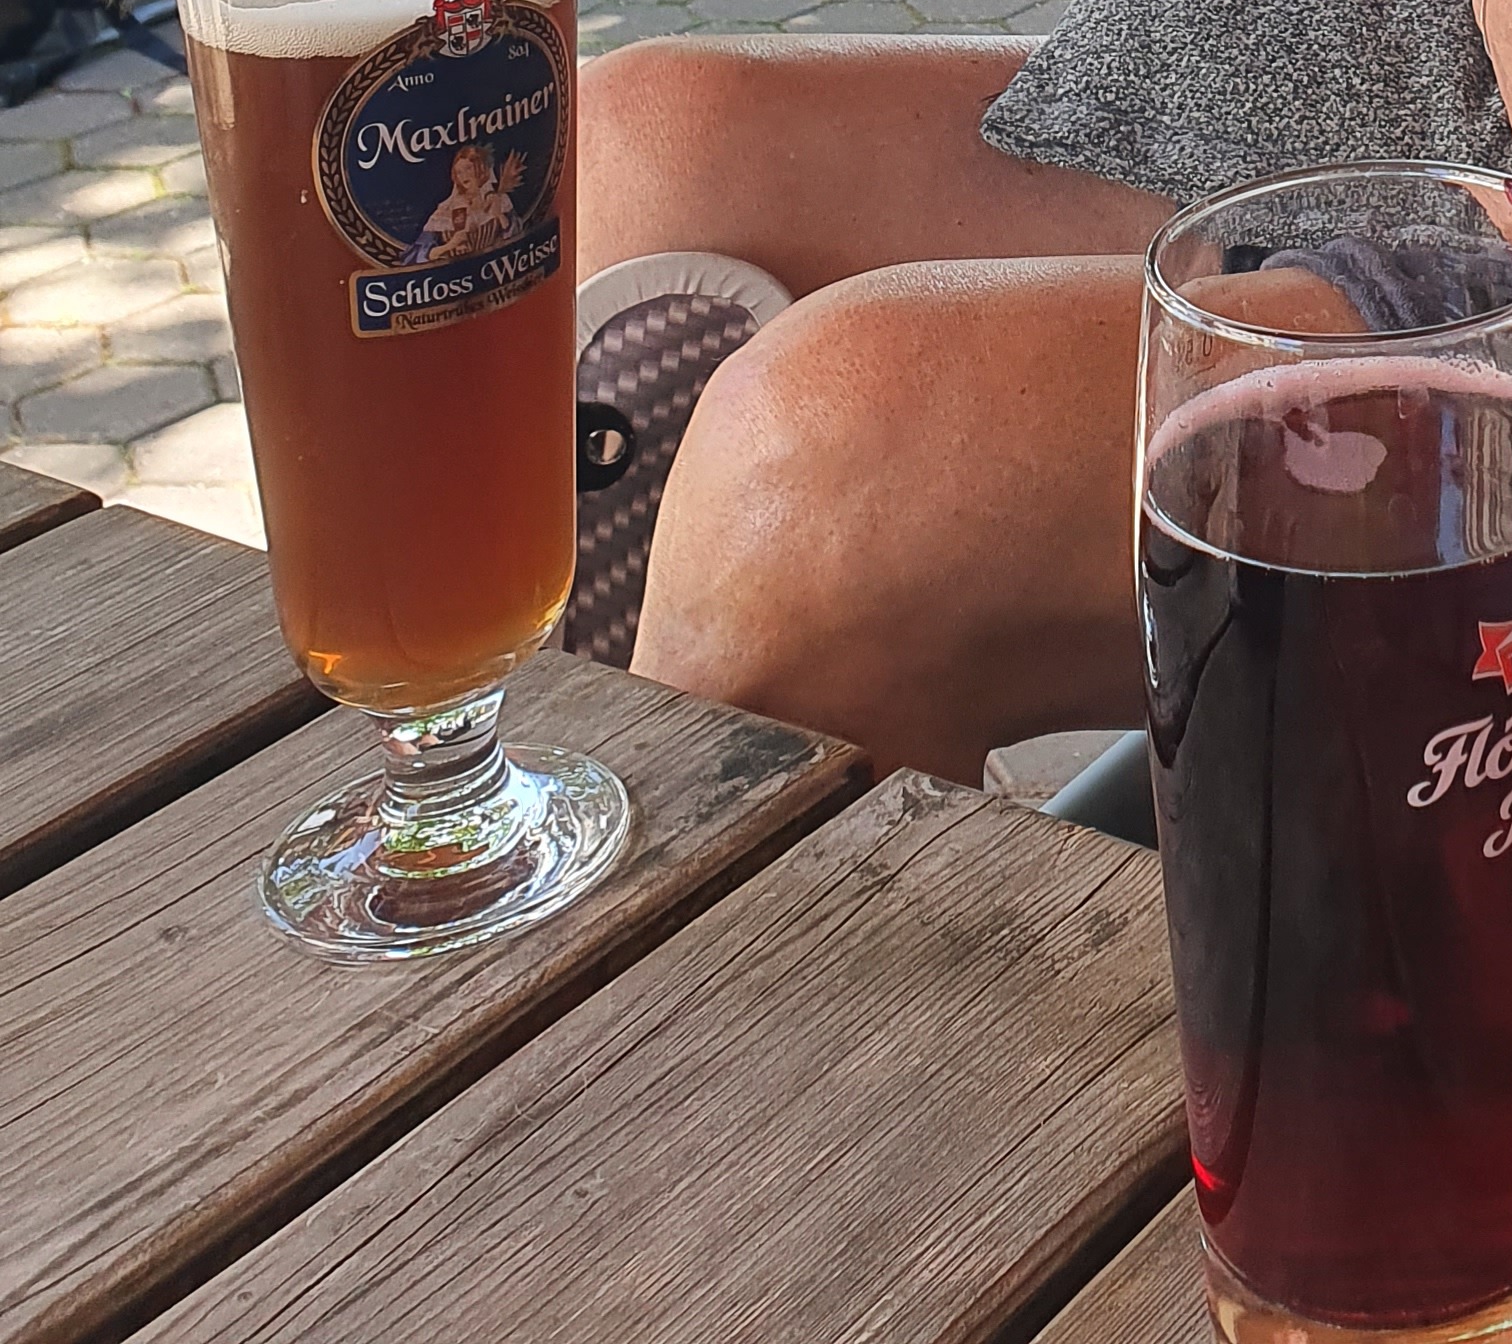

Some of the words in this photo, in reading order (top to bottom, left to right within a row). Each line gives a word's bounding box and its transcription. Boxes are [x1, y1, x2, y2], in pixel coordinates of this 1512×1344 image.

[387, 72, 435, 92] Anno
[357, 82, 555, 170] Maxlrainer
[362, 274, 474, 318] Schloss
